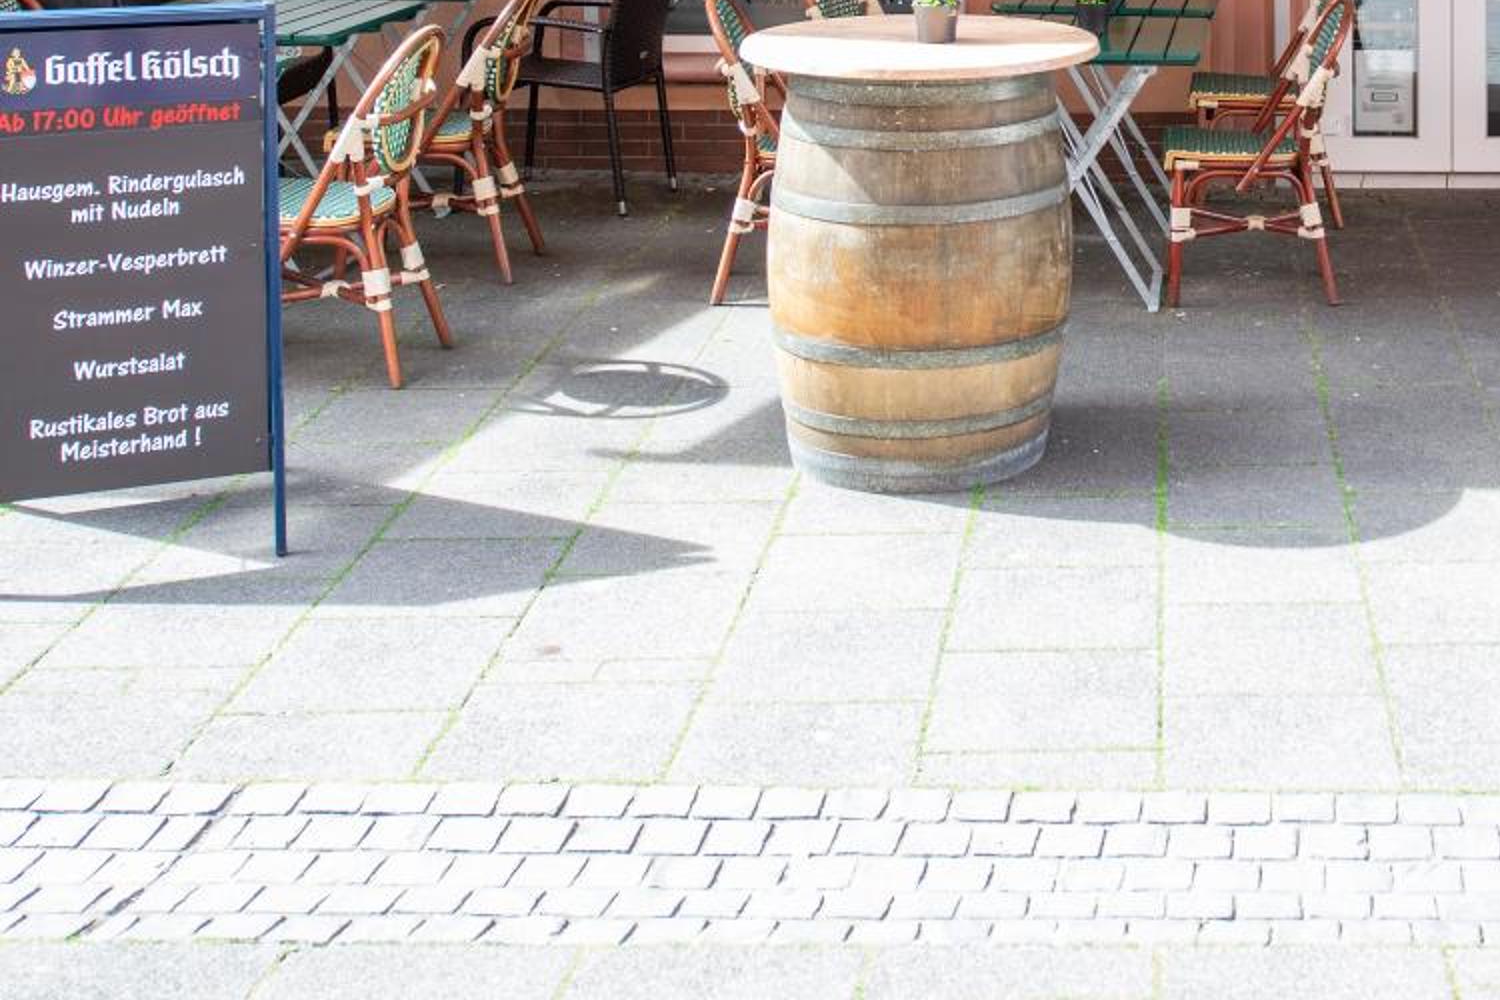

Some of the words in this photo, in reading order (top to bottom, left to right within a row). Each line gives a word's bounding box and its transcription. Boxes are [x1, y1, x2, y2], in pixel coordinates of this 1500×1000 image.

[45, 52, 136, 86] Gaffel
[141, 47, 240, 80] Kölsch
[0, 115, 25, 133] Ab
[32, 109, 95, 131] 17:00
[103, 105, 143, 127] Uhr
[150, 103, 241, 129] geöffnet
[1, 182, 100, 203] Hausgem.
[108, 165, 245, 195] Rindergulasch
[71, 203, 103, 223] mit
[111, 198, 180, 220] Nudeln
[24, 245, 228, 280] Winzer-Vesperbrett
[52, 305, 155, 330] Strammer
[161, 299, 203, 319] Max
[74, 351, 187, 381] Wurstsalat
[30, 411, 136, 440] Rustikales
[143, 404, 188, 426] Brot
[194, 401, 229, 420] aus
[60, 429, 188, 463] Meisterhand
[195, 426, 202, 446] !
